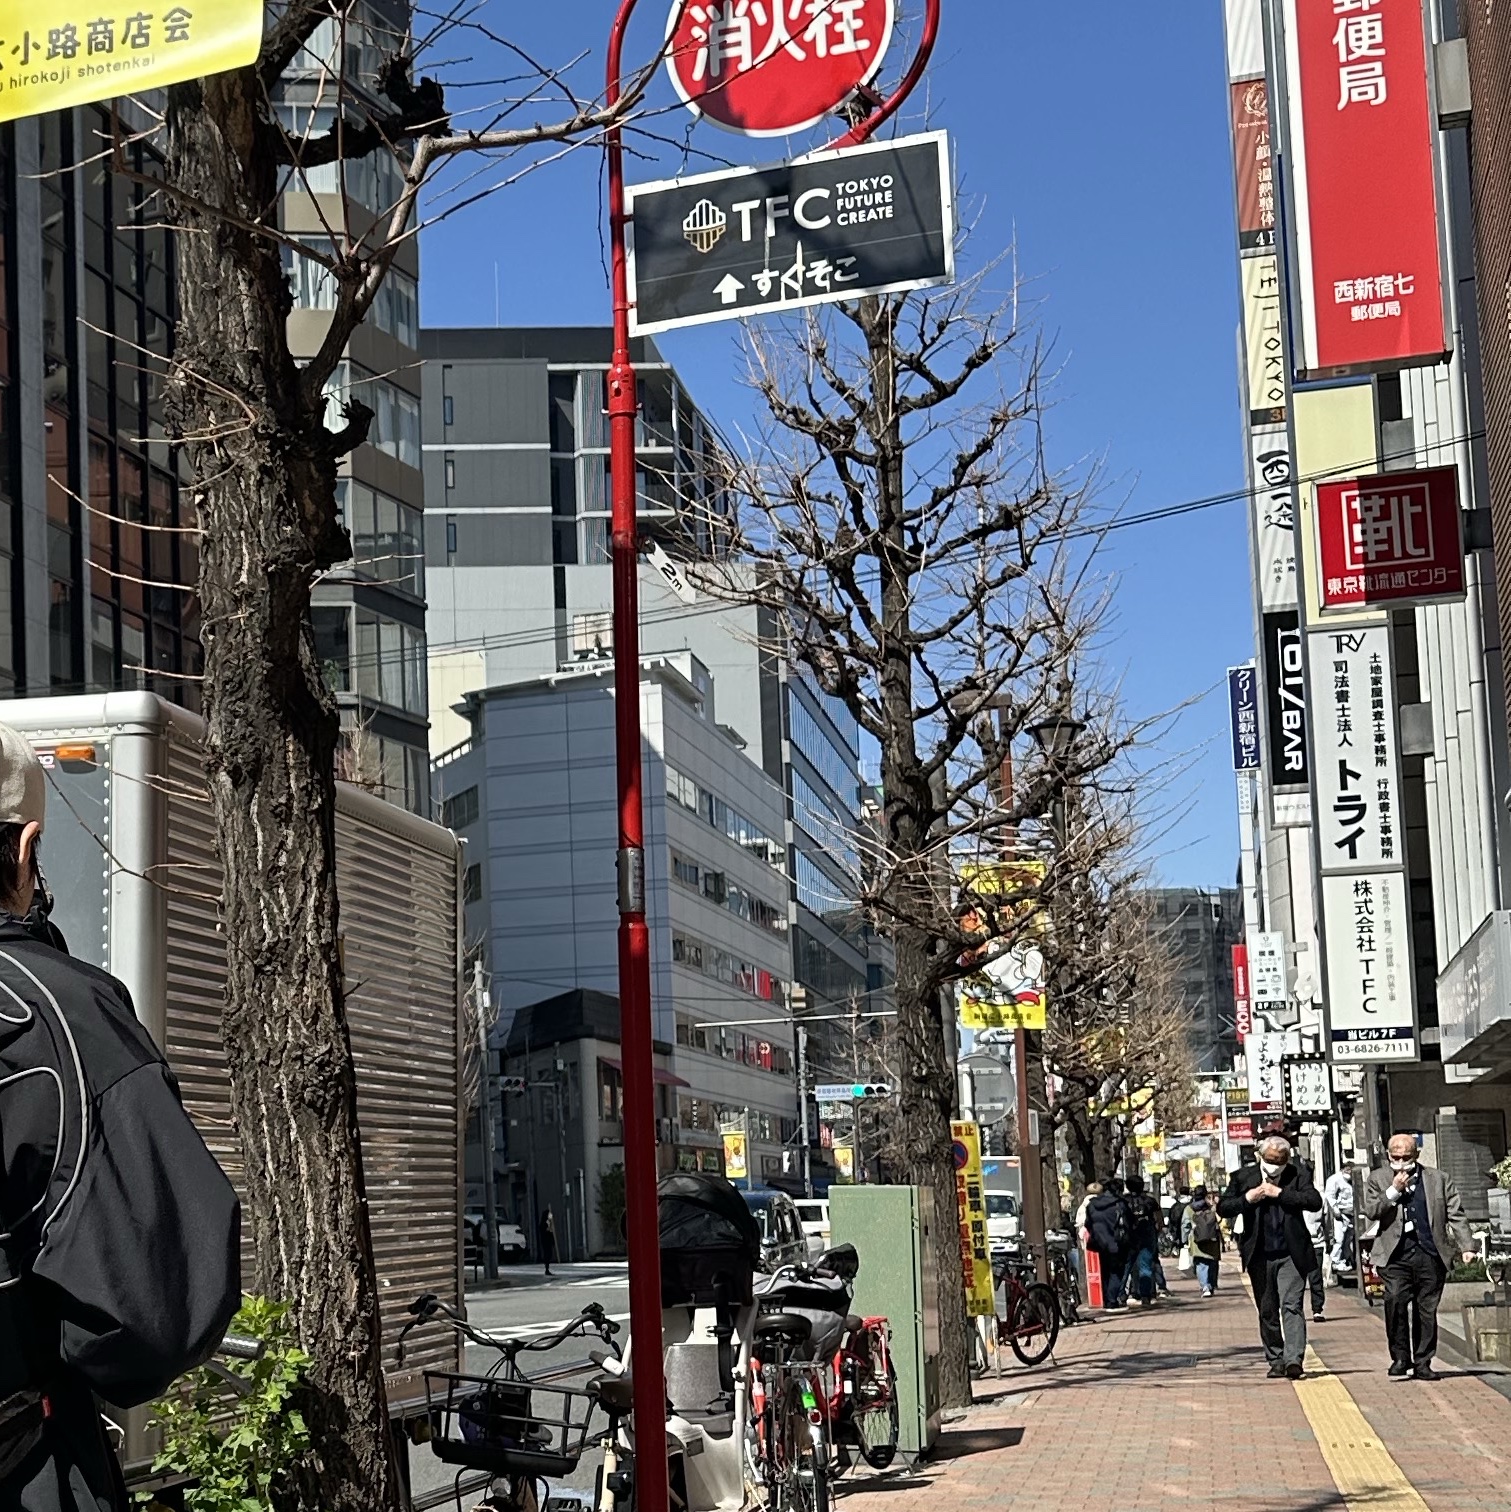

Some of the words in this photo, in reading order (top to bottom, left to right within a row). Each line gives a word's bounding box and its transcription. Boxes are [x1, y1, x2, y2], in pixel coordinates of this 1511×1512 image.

[690, 0, 871, 82] 消火栓
[9, 67, 71, 90] hirokoji
[77, 54, 156, 78] shotenkai
[836, 174, 894, 196] TOKYO
[731, 188, 832, 242] TFC
[836, 190, 893, 212] FUTURE
[836, 206, 894, 227] CREATE
[1333, 272, 1416, 304] 西新宿七
[1350, 301, 1401, 322] 郵便局
[1270, 408, 1285, 422] 3
[1350, 495, 1426, 562] 靴
[660, 562, 683, 592] 2m
[1327, 567, 1459, 596] 東京靴流通センター
[1328, 632, 1367, 655] TRY
[1237, 669, 1259, 769] クリーン西新宿ビル
[1333, 660, 1354, 748] 司法書士法人
[1333, 758, 1368, 860] トライ
[1377, 778, 1394, 860] 行政書士事務所
[1337, 1042, 1410, 1055] 03-6826-7111
